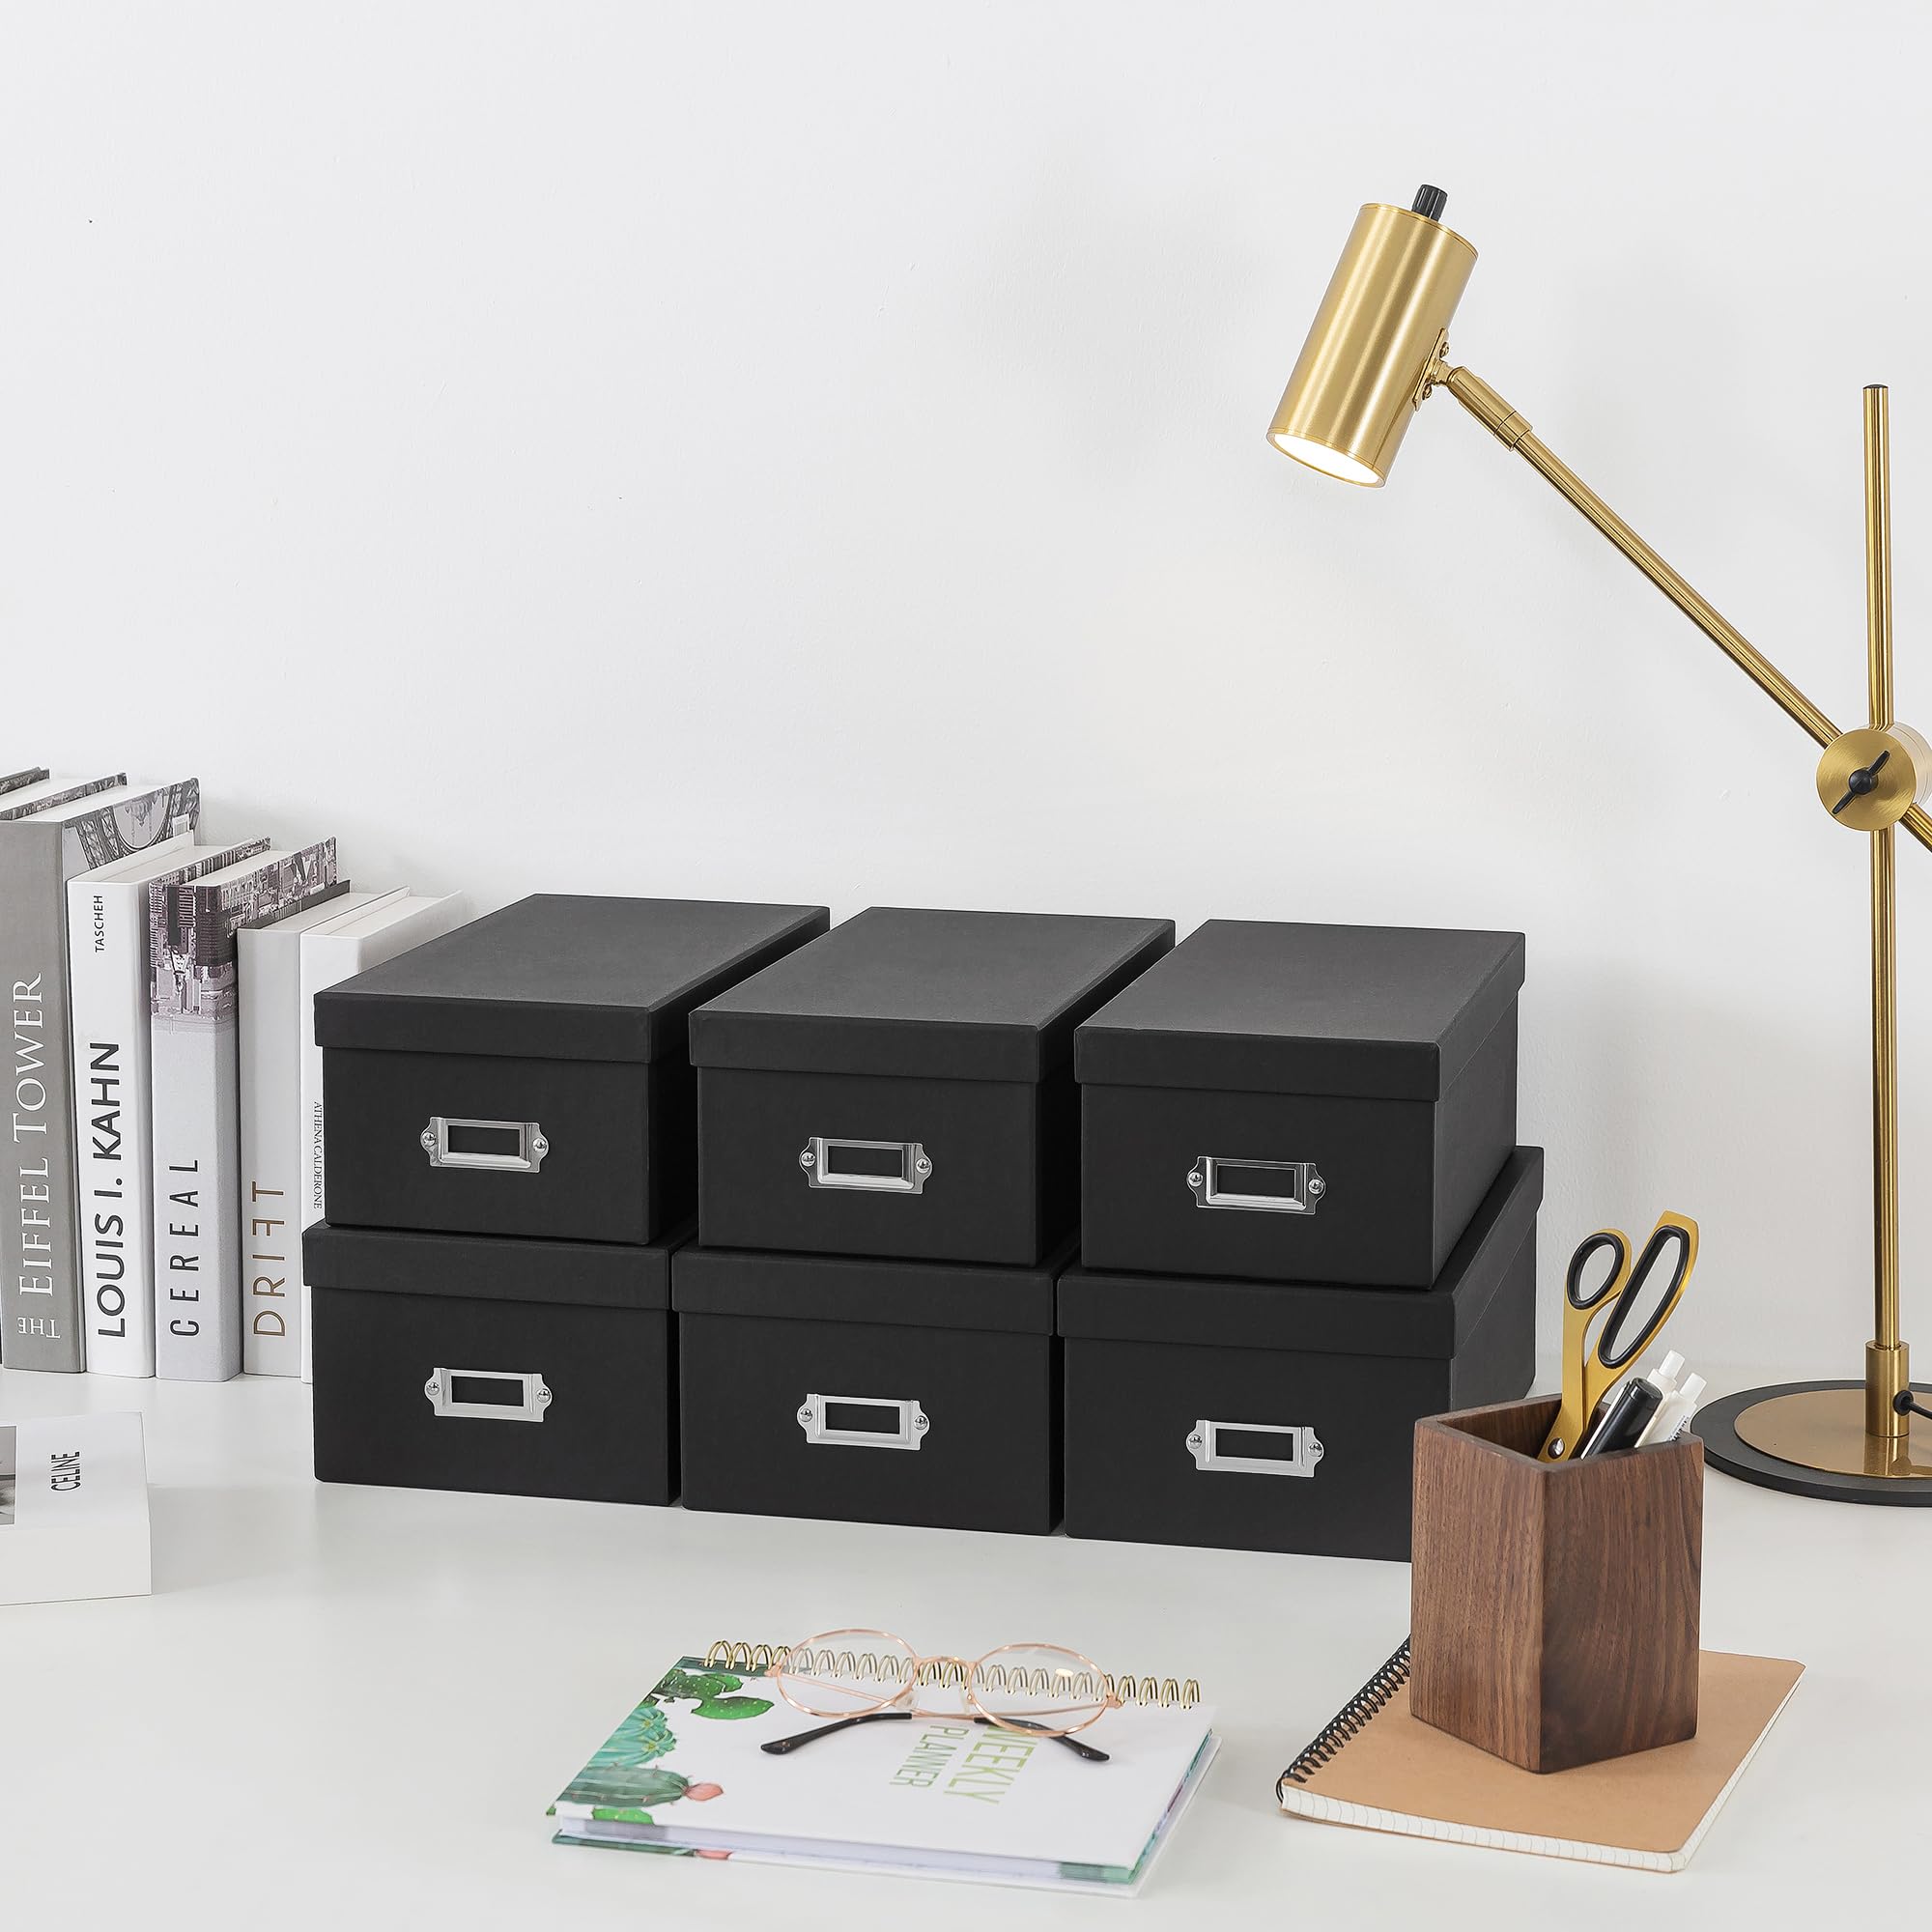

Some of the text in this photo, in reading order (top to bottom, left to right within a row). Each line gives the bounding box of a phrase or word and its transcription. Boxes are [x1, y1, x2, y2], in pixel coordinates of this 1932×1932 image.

[12, 972, 53, 1297] EIFFEL TOWER
[89, 1042, 126, 1338] LOUIS I. KAHN
[313, 1101, 323, 1209] ATHENA CALDERONE
[168, 1159, 200, 1337] CEREAL
[251, 1180, 286, 1337] DRIFT
[17, 1317, 61, 1340] THE
[50, 1451, 81, 1492] CELINE
[889, 1725, 970, 1789] PLANNER
